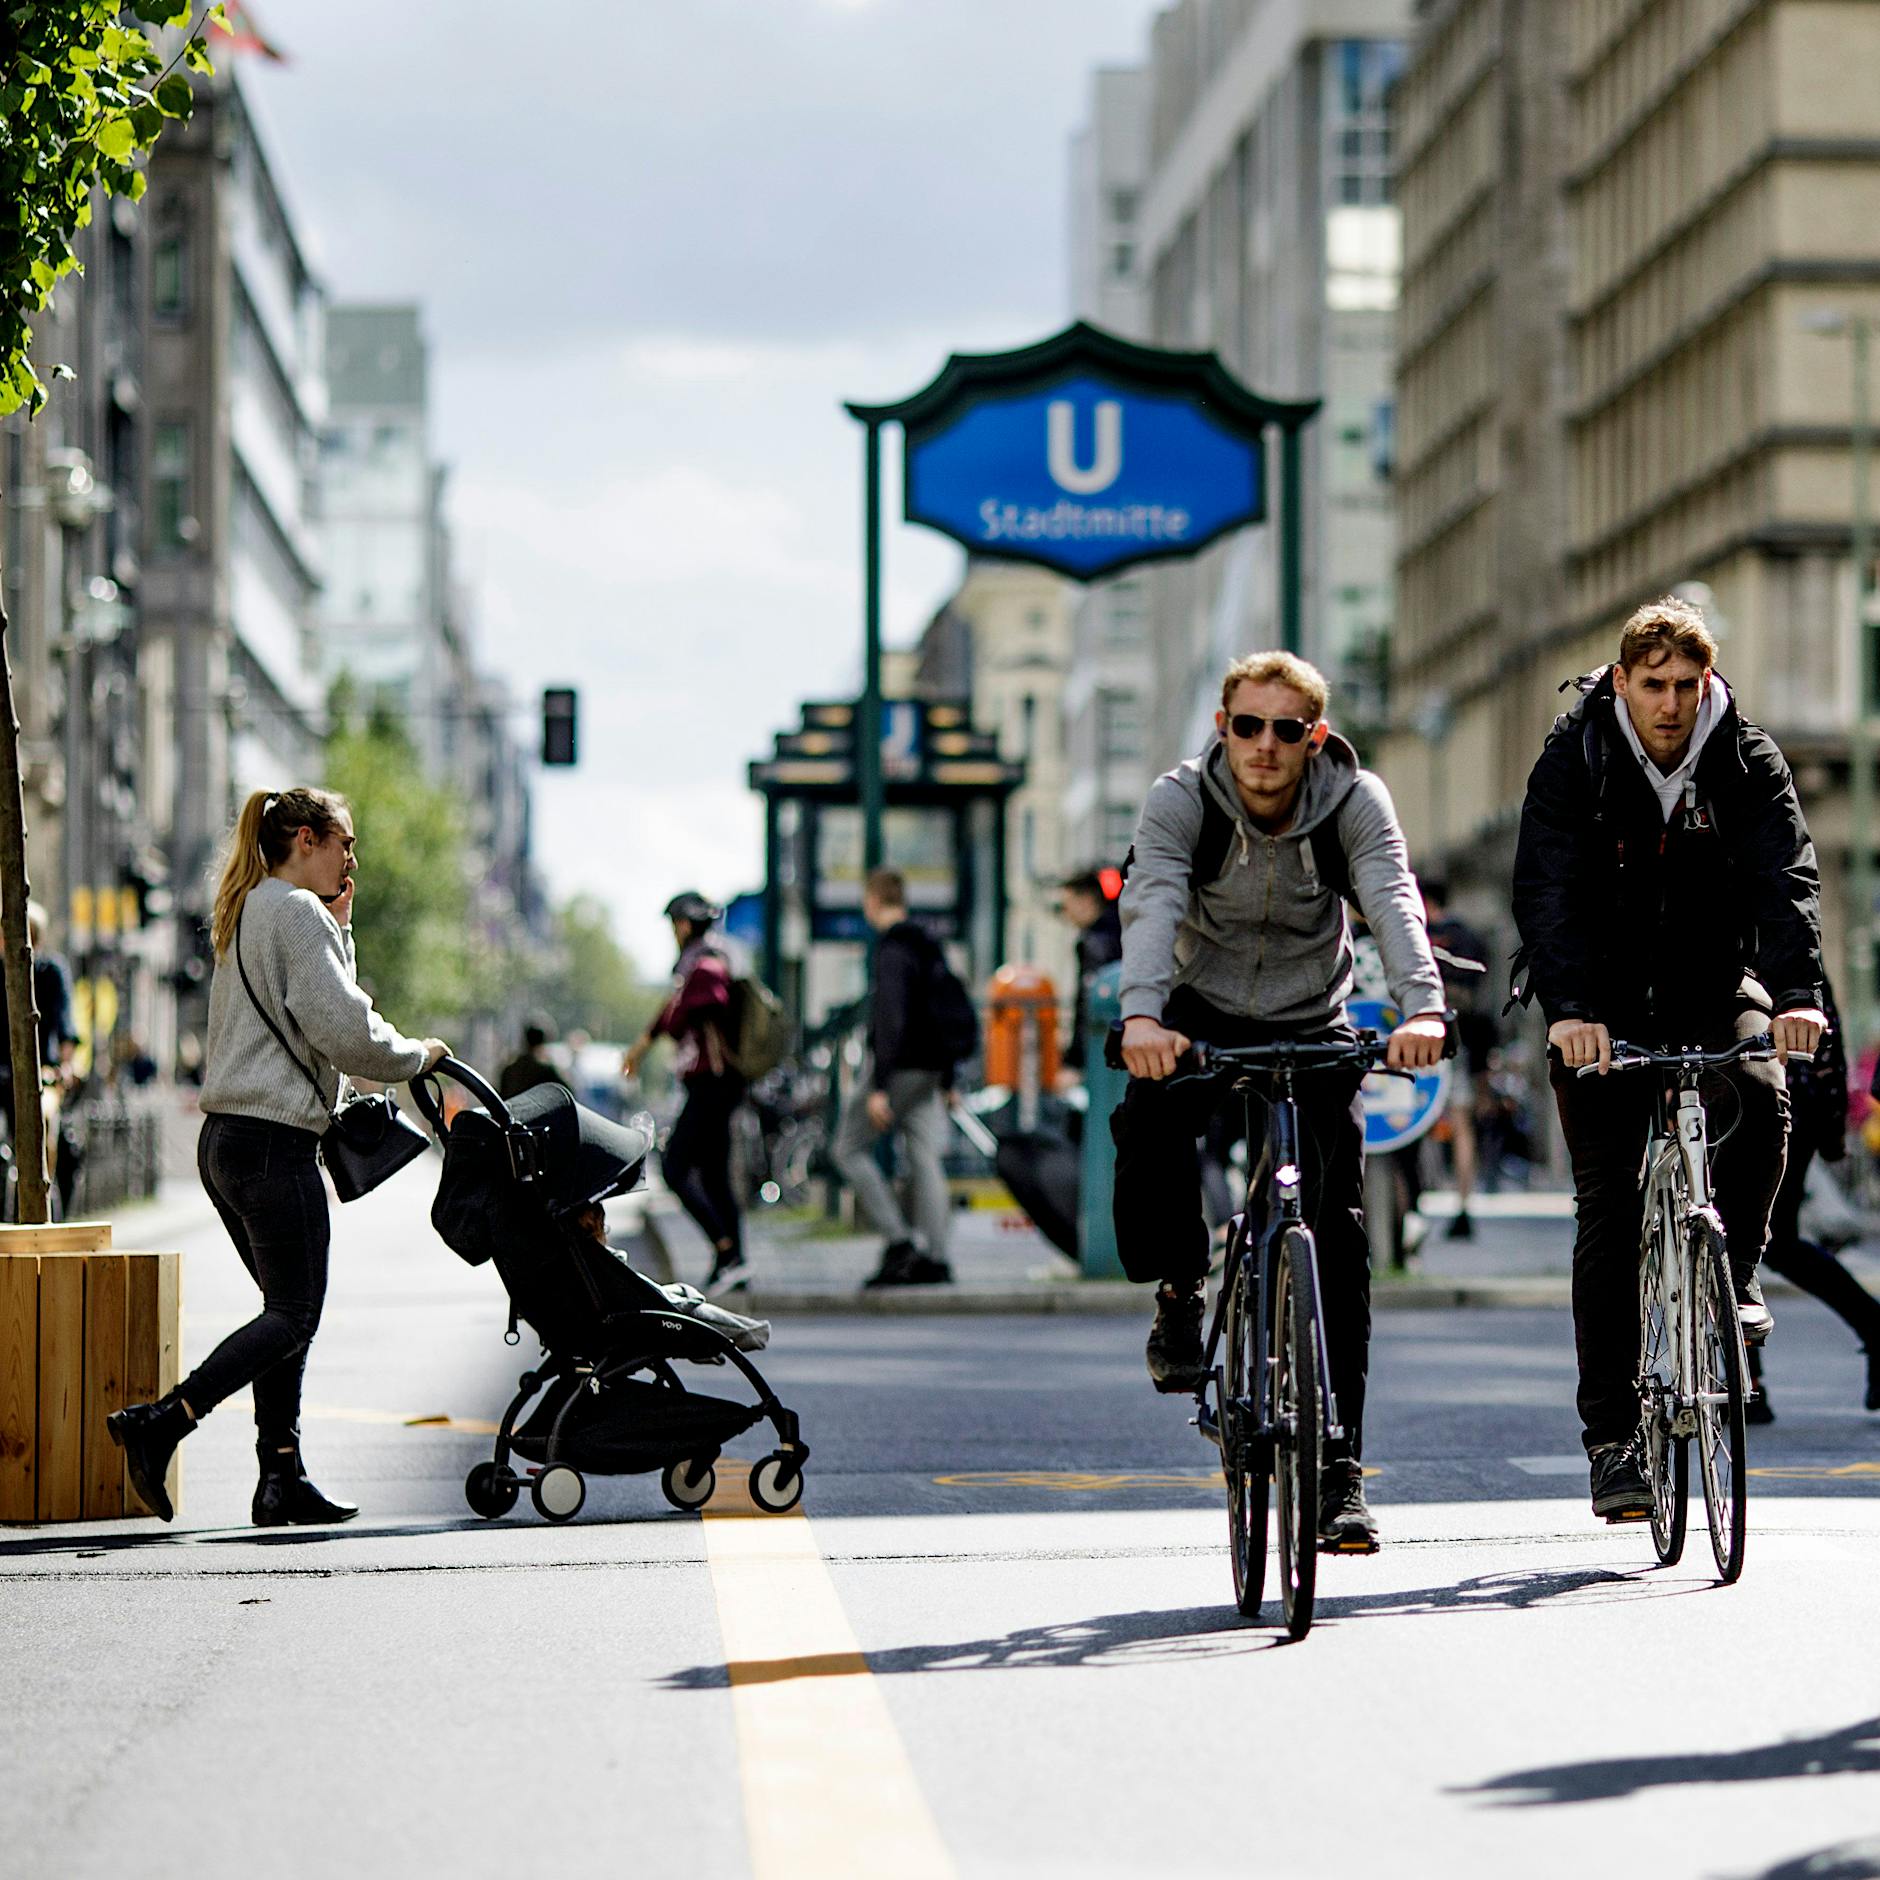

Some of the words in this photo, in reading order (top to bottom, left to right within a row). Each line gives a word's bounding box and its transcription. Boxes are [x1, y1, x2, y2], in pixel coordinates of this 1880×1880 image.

[1047, 400, 1122, 495] U
[979, 499, 1190, 540] Stadtmitte
[661, 1319, 683, 1331] YOYO
